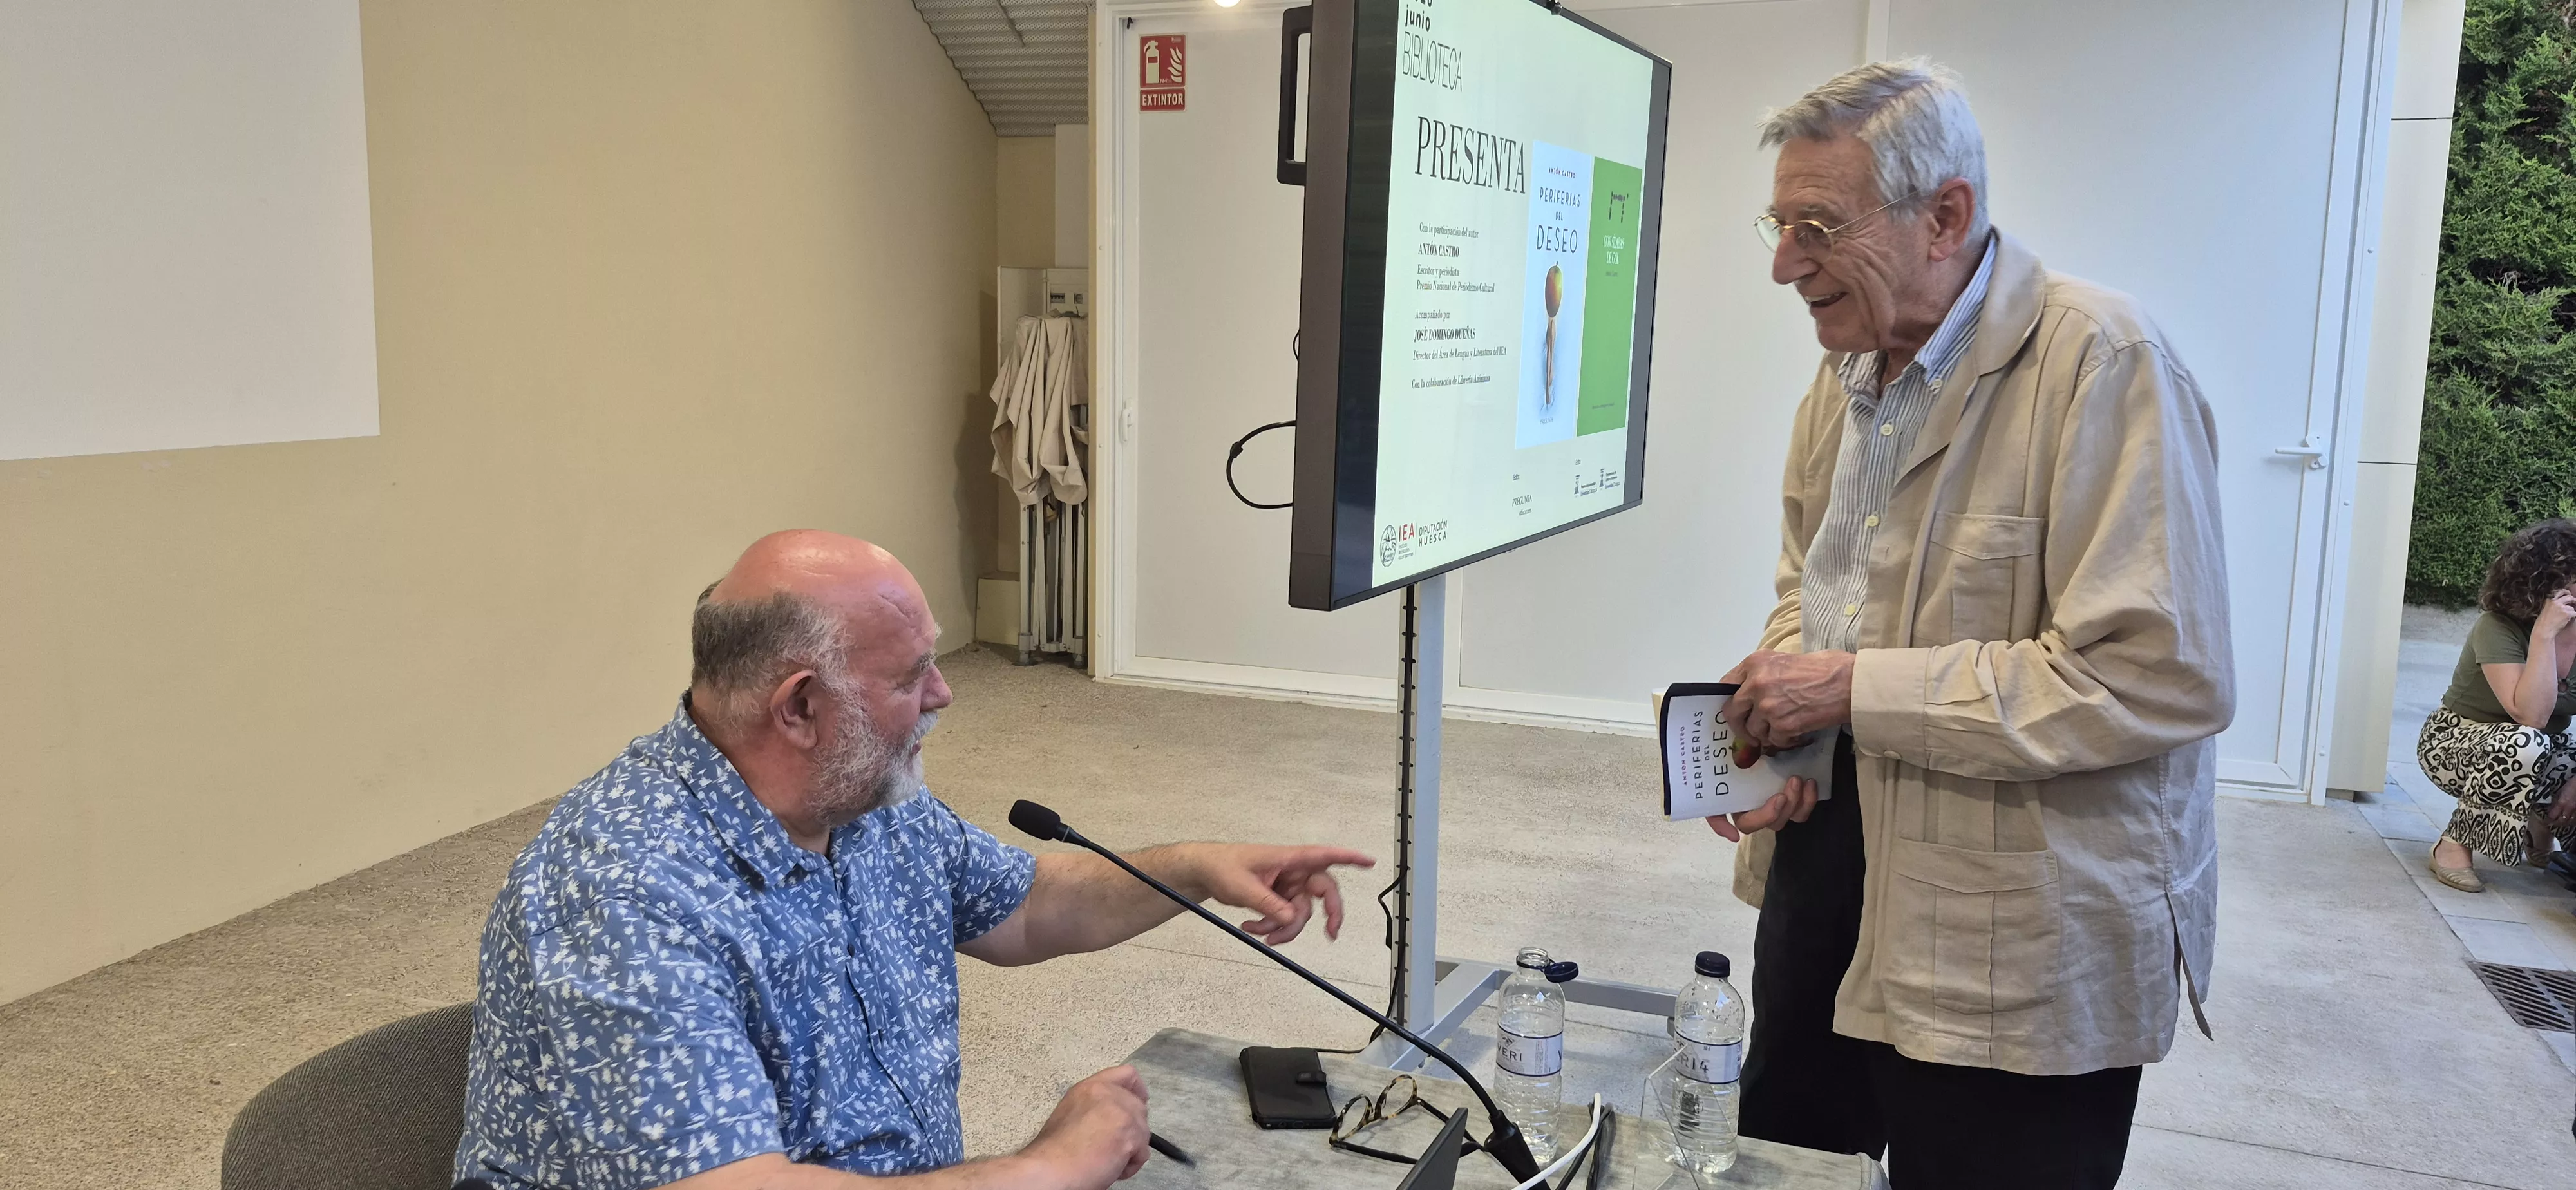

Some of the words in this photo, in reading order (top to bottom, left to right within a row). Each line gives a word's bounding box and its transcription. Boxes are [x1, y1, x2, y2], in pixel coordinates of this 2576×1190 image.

[1405, 4, 1430, 32] junio
[1403, 31, 1462, 92] BIBLIOTECA
[1142, 93, 1183, 106] EXTINTOR
[1415, 116, 1526, 194] PRESENTA
[1540, 186, 1580, 207] PERIFERIAS
[1419, 222, 1428, 232] Con
[1429, 222, 1433, 232] la
[1434, 225, 1461, 238] participación
[1537, 225, 1578, 253] DESEO
[1418, 240, 1437, 256] ANTÓN
[1438, 245, 1459, 258] CASTRO
[1417, 264, 1435, 276] Escritor
[1439, 266, 1459, 278] periodista
[1416, 279, 1432, 290] Premio
[1433, 280, 1452, 291] Nacional
[1452, 281, 1457, 291] de
[1457, 281, 1479, 292] Periodismo
[1479, 282, 1495, 292] Cultural
[1415, 309, 1443, 322] Acompañado
[1414, 326, 1428, 342] JOSÉ
[1429, 328, 1454, 341] DOMINGO
[1455, 325, 1475, 340] DUEÑAS
[1413, 350, 1431, 361] Director
[1439, 346, 1448, 359] Área
[1449, 348, 1454, 358] de
[1455, 348, 1469, 361] Lengua
[1473, 347, 1492, 357] Literatura
[1412, 379, 1420, 389] Con
[1421, 378, 1425, 388] la
[1426, 376, 1452, 387] colaboración
[1452, 375, 1457, 385] de
[1457, 374, 1473, 385] Librería
[1399, 522, 1414, 542] IEA
[1419, 518, 1448, 536] DIPUTACIÓN
[1419, 531, 1446, 547] HUESCA
[1692, 710, 1703, 800] PERIFERIAS
[1497, 1043, 1522, 1062] VERI
